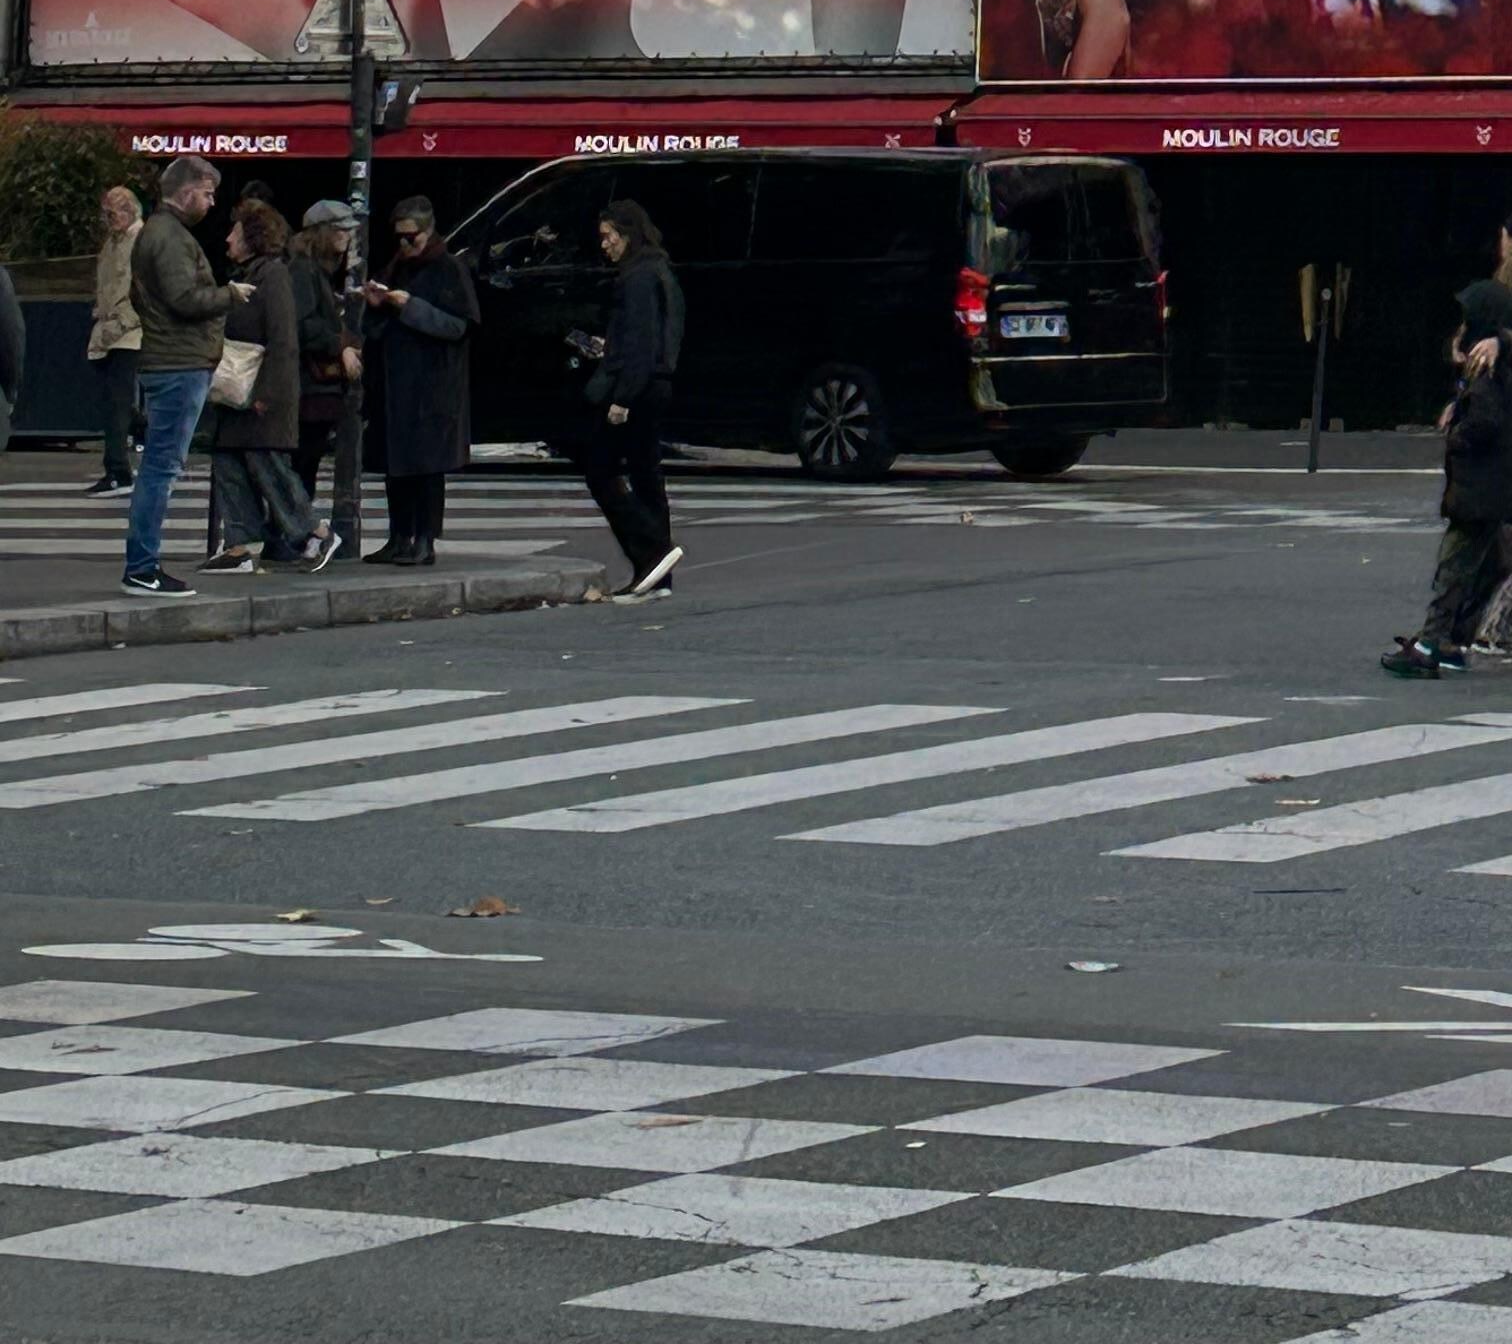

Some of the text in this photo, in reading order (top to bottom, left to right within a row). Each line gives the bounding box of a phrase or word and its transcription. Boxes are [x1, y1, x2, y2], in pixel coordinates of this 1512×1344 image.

[131, 135, 289, 153] MOULIN ROUGE
[574, 134, 740, 153] MOULIN ROUGE
[1162, 128, 1341, 148] MOULIN ROUGE
